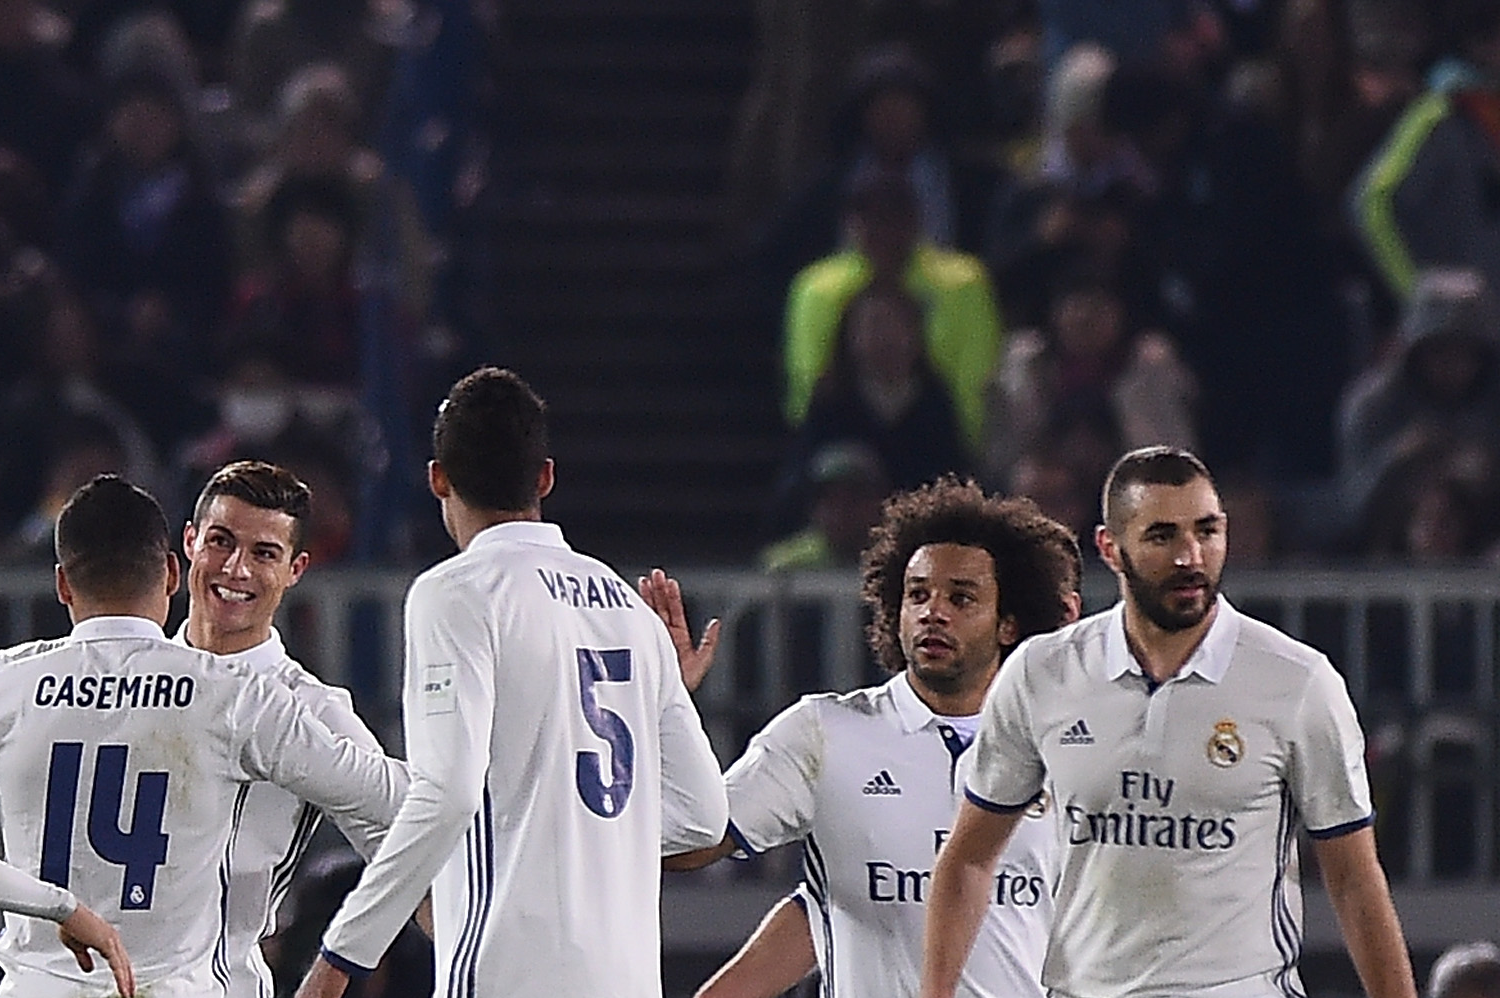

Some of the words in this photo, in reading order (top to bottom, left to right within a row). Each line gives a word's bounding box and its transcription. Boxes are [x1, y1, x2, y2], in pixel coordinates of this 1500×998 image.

[537, 568, 635, 610] VARANE
[575, 647, 635, 820] 5
[1121, 771, 1174, 808] Fly
[40, 742, 170, 911] 14
[1066, 803, 1236, 850] Emirates
[866, 862, 1044, 907] Emtes
